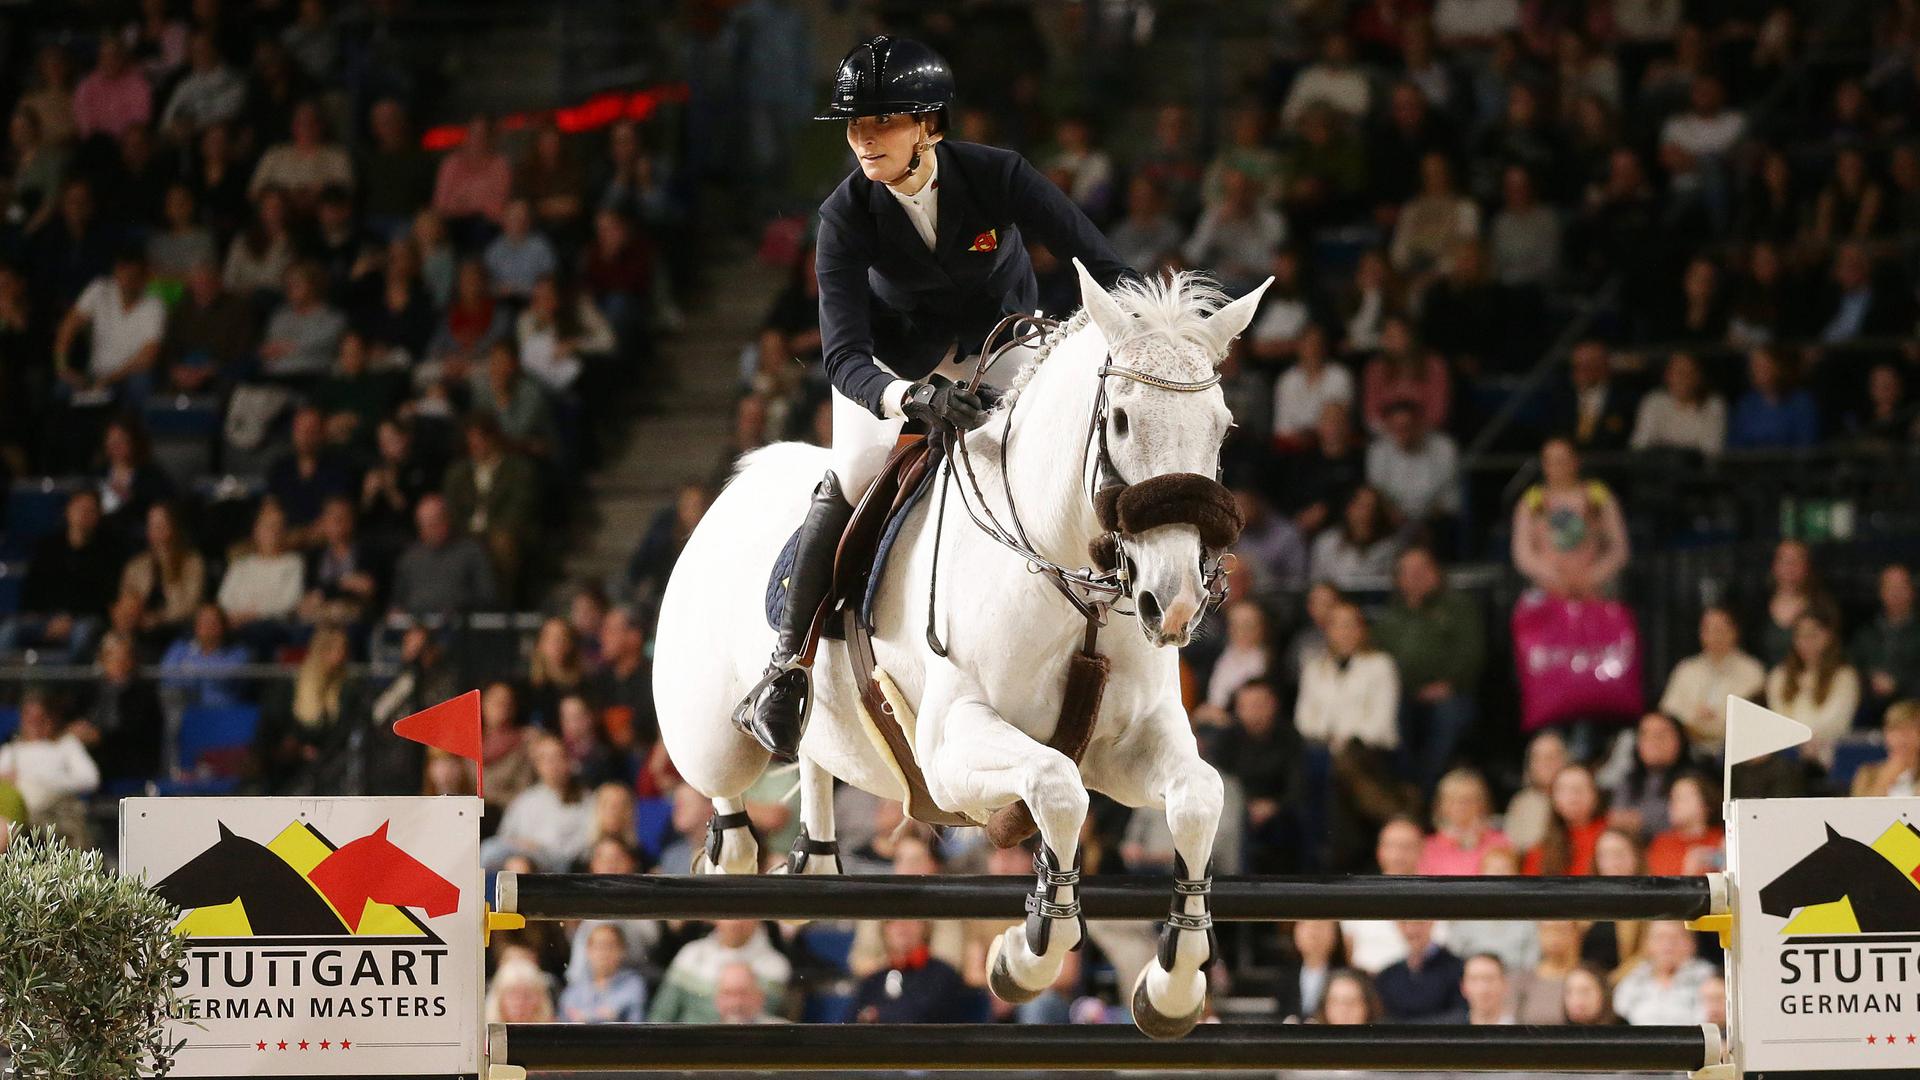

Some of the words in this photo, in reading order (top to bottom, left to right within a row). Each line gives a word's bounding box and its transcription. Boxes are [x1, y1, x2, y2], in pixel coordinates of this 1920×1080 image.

[1780, 947, 1920, 984] STUTT
[310, 996, 447, 1018] MASTERS
[1780, 993, 1901, 1015] GERMAN
